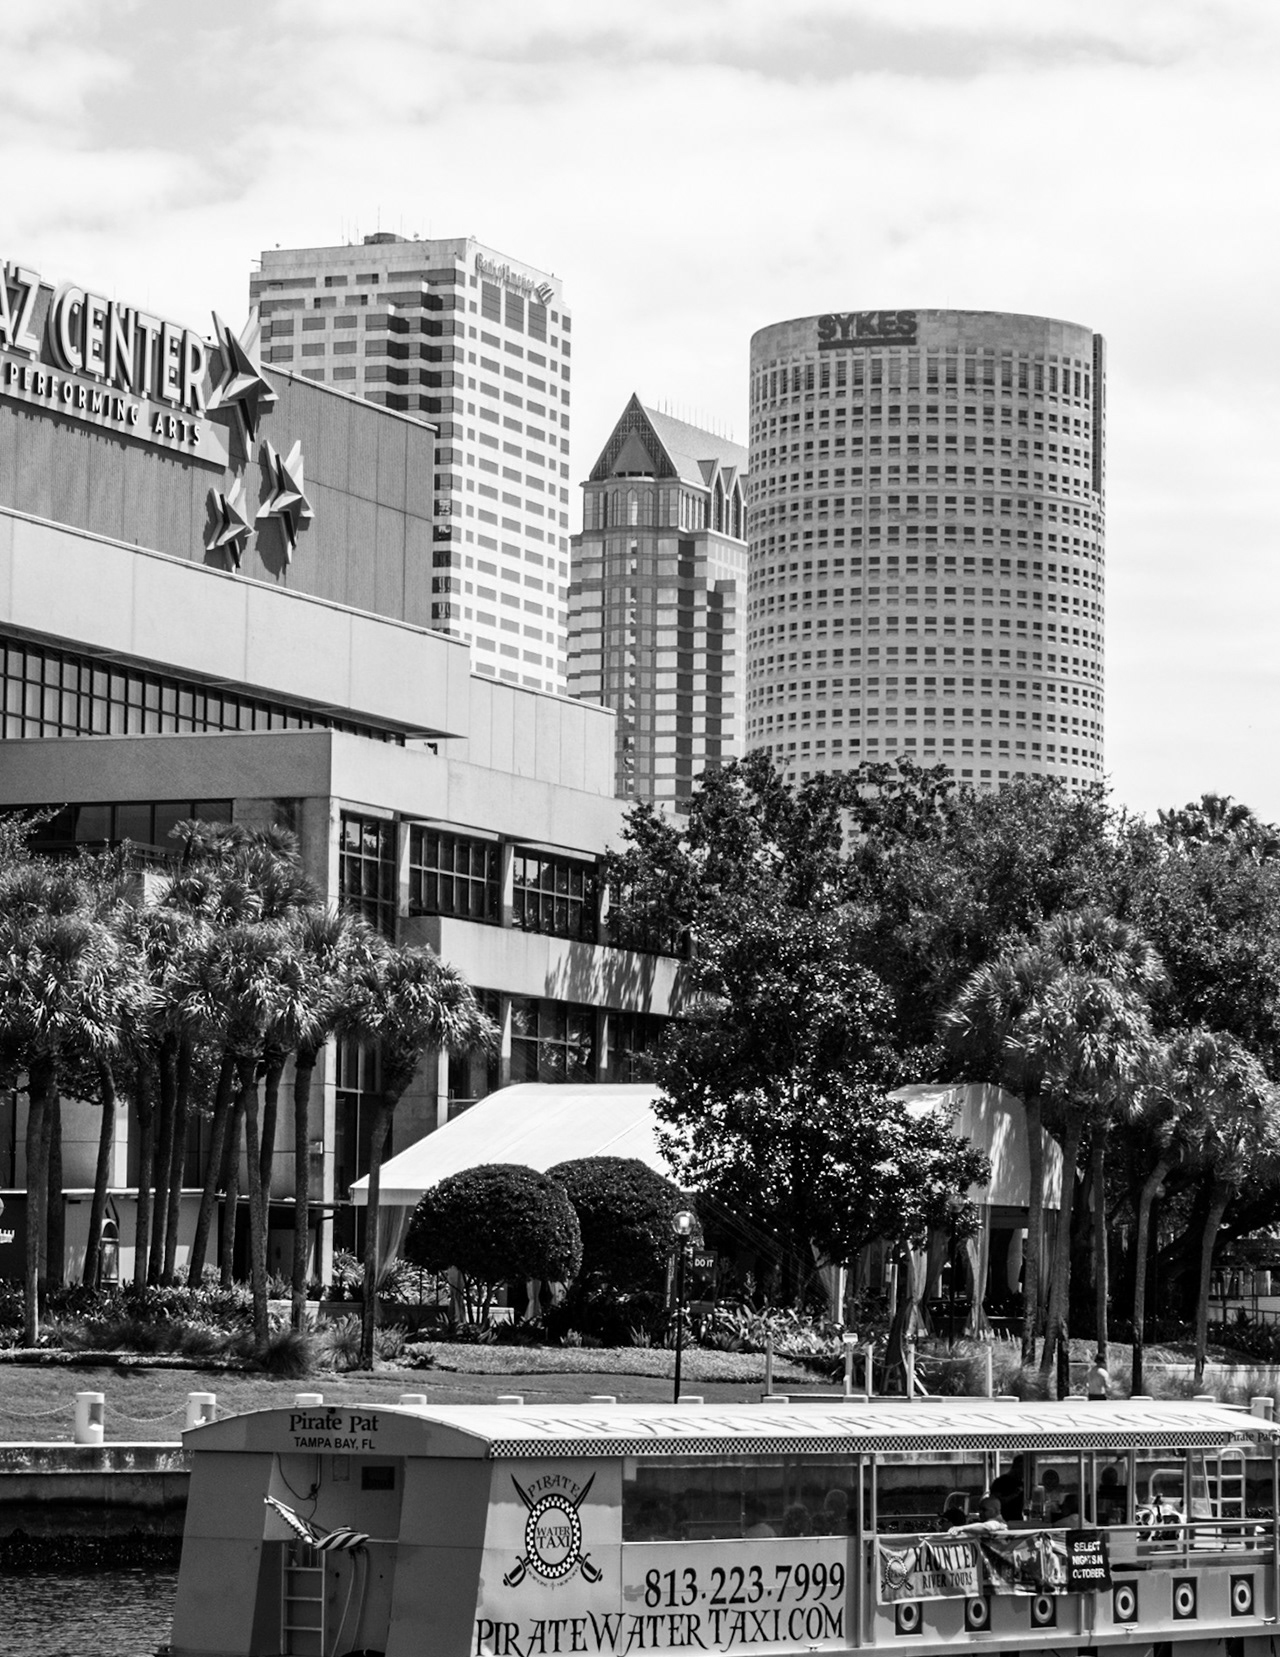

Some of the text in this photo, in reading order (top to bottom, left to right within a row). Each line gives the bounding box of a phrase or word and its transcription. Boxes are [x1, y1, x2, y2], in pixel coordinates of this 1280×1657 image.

[817, 310, 917, 341] SYKES
[55, 286, 207, 412] CENTER
[7, 361, 140, 426] PERFORMING
[154, 411, 201, 446] ARTS
[694, 1258, 714, 1268] DO IT
[289, 1411, 379, 1434] Pirate Pat
[294, 1436, 376, 1451] TAMPA BAY, FL
[1228, 1431, 1255, 1443] Pirate
[527, 1474, 581, 1498] PIRATE
[536, 1526, 571, 1537] WATER
[536, 1535, 570, 1549] TAXI
[1073, 1540, 1101, 1553] SELECT
[913, 1542, 979, 1574] HAUNTED
[922, 1573, 947, 1590] RIVER
[950, 1571, 973, 1588] TOURS
[1072, 1568, 1106, 1579] OCTOBER
[644, 1562, 846, 1608] 813.223.7999
